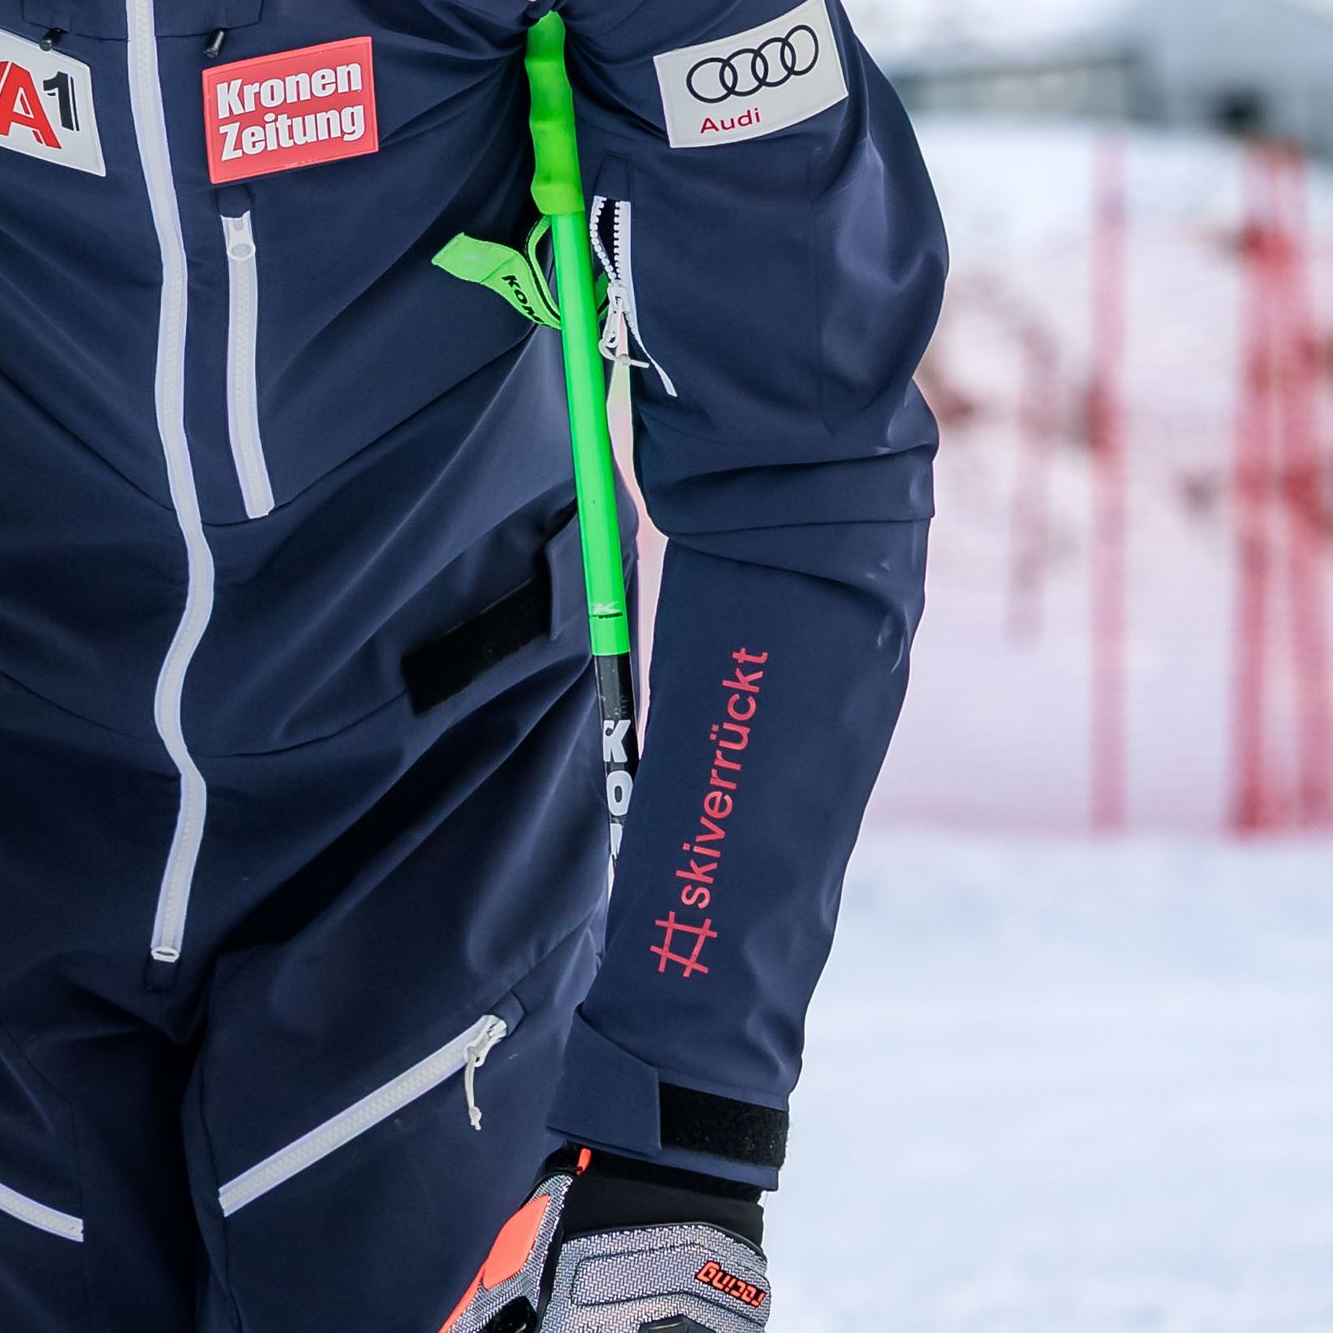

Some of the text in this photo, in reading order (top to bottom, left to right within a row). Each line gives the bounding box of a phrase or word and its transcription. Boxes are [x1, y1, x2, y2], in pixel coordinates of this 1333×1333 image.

[217, 62, 363, 119] Kronen
[219, 105, 366, 161] Zeitung
[700, 107, 761, 133] Audi
[649, 646, 769, 979] #skiverrückt
[697, 1261, 766, 1307] racing
